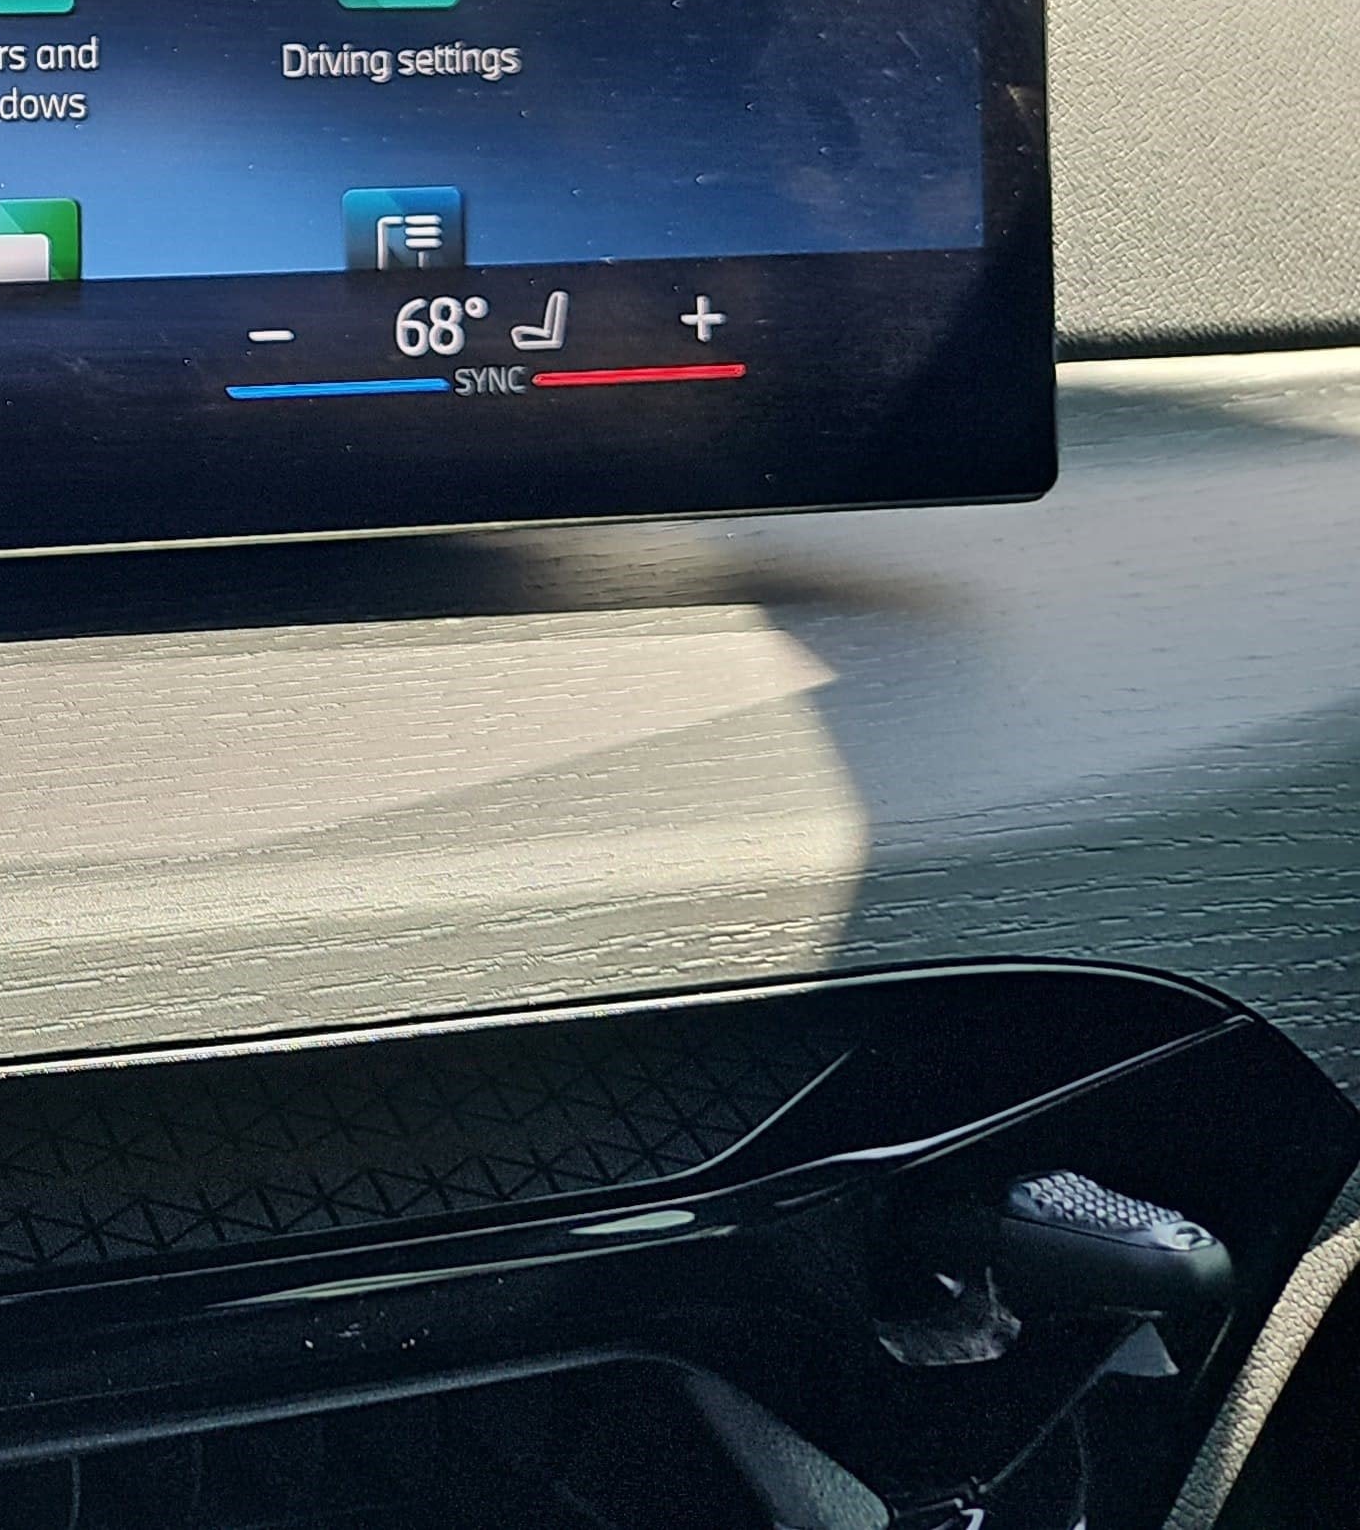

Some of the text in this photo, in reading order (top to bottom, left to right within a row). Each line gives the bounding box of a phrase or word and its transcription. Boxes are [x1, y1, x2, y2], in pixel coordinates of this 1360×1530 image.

[35, 35, 100, 71] and
[281, 42, 522, 82] Driving settings
[452, 364, 527, 395] SYNC
